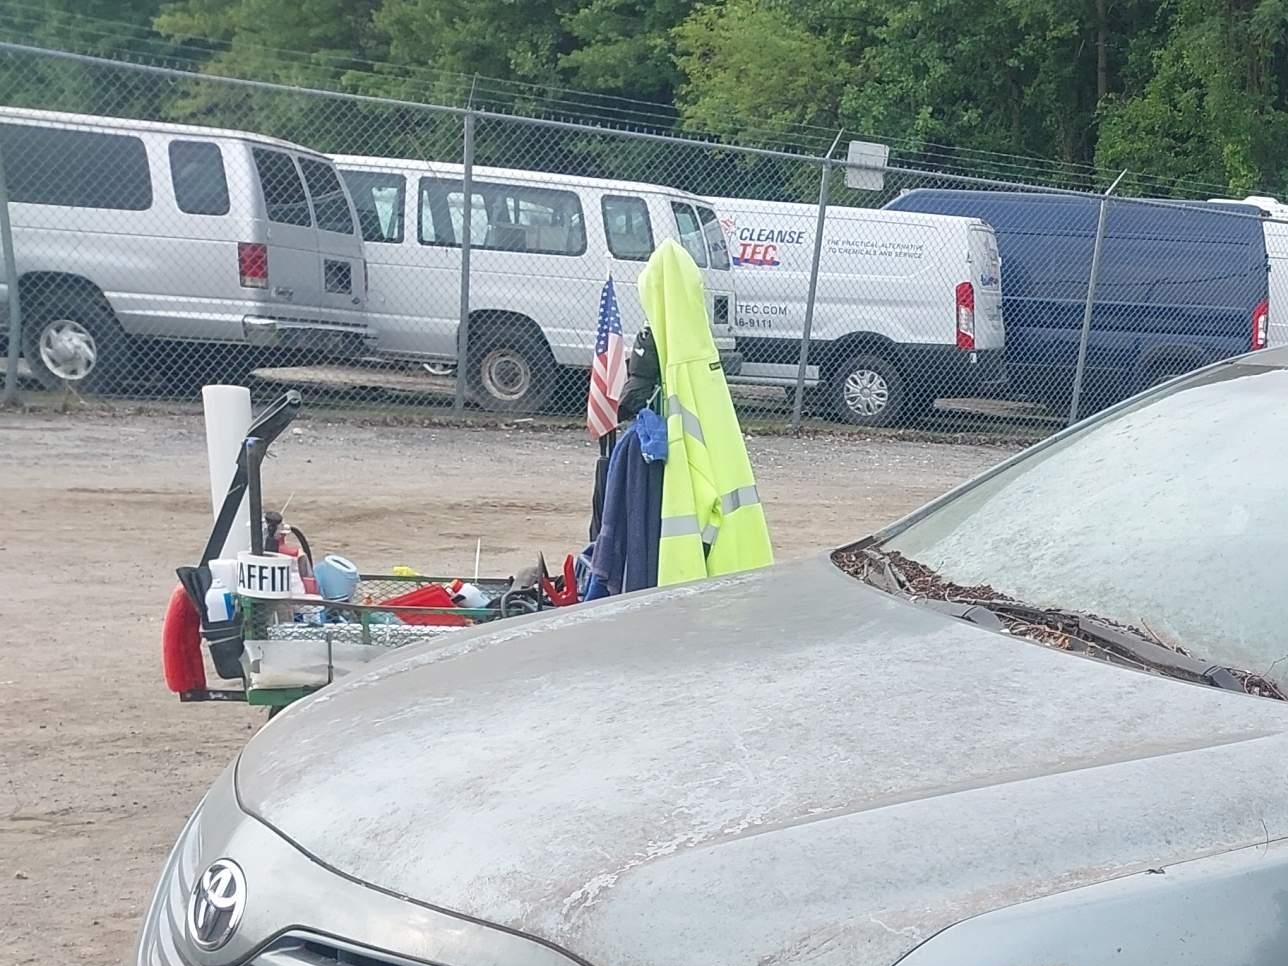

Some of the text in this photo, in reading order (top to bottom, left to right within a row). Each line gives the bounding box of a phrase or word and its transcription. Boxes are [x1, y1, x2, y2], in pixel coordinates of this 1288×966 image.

[739, 227, 805, 244] CLEANSE
[838, 247, 877, 256] CHEMICALS
[841, 240, 878, 249] PRACTICAL
[739, 243, 777, 265] TEC
[238, 562, 290, 592] AFFITI
